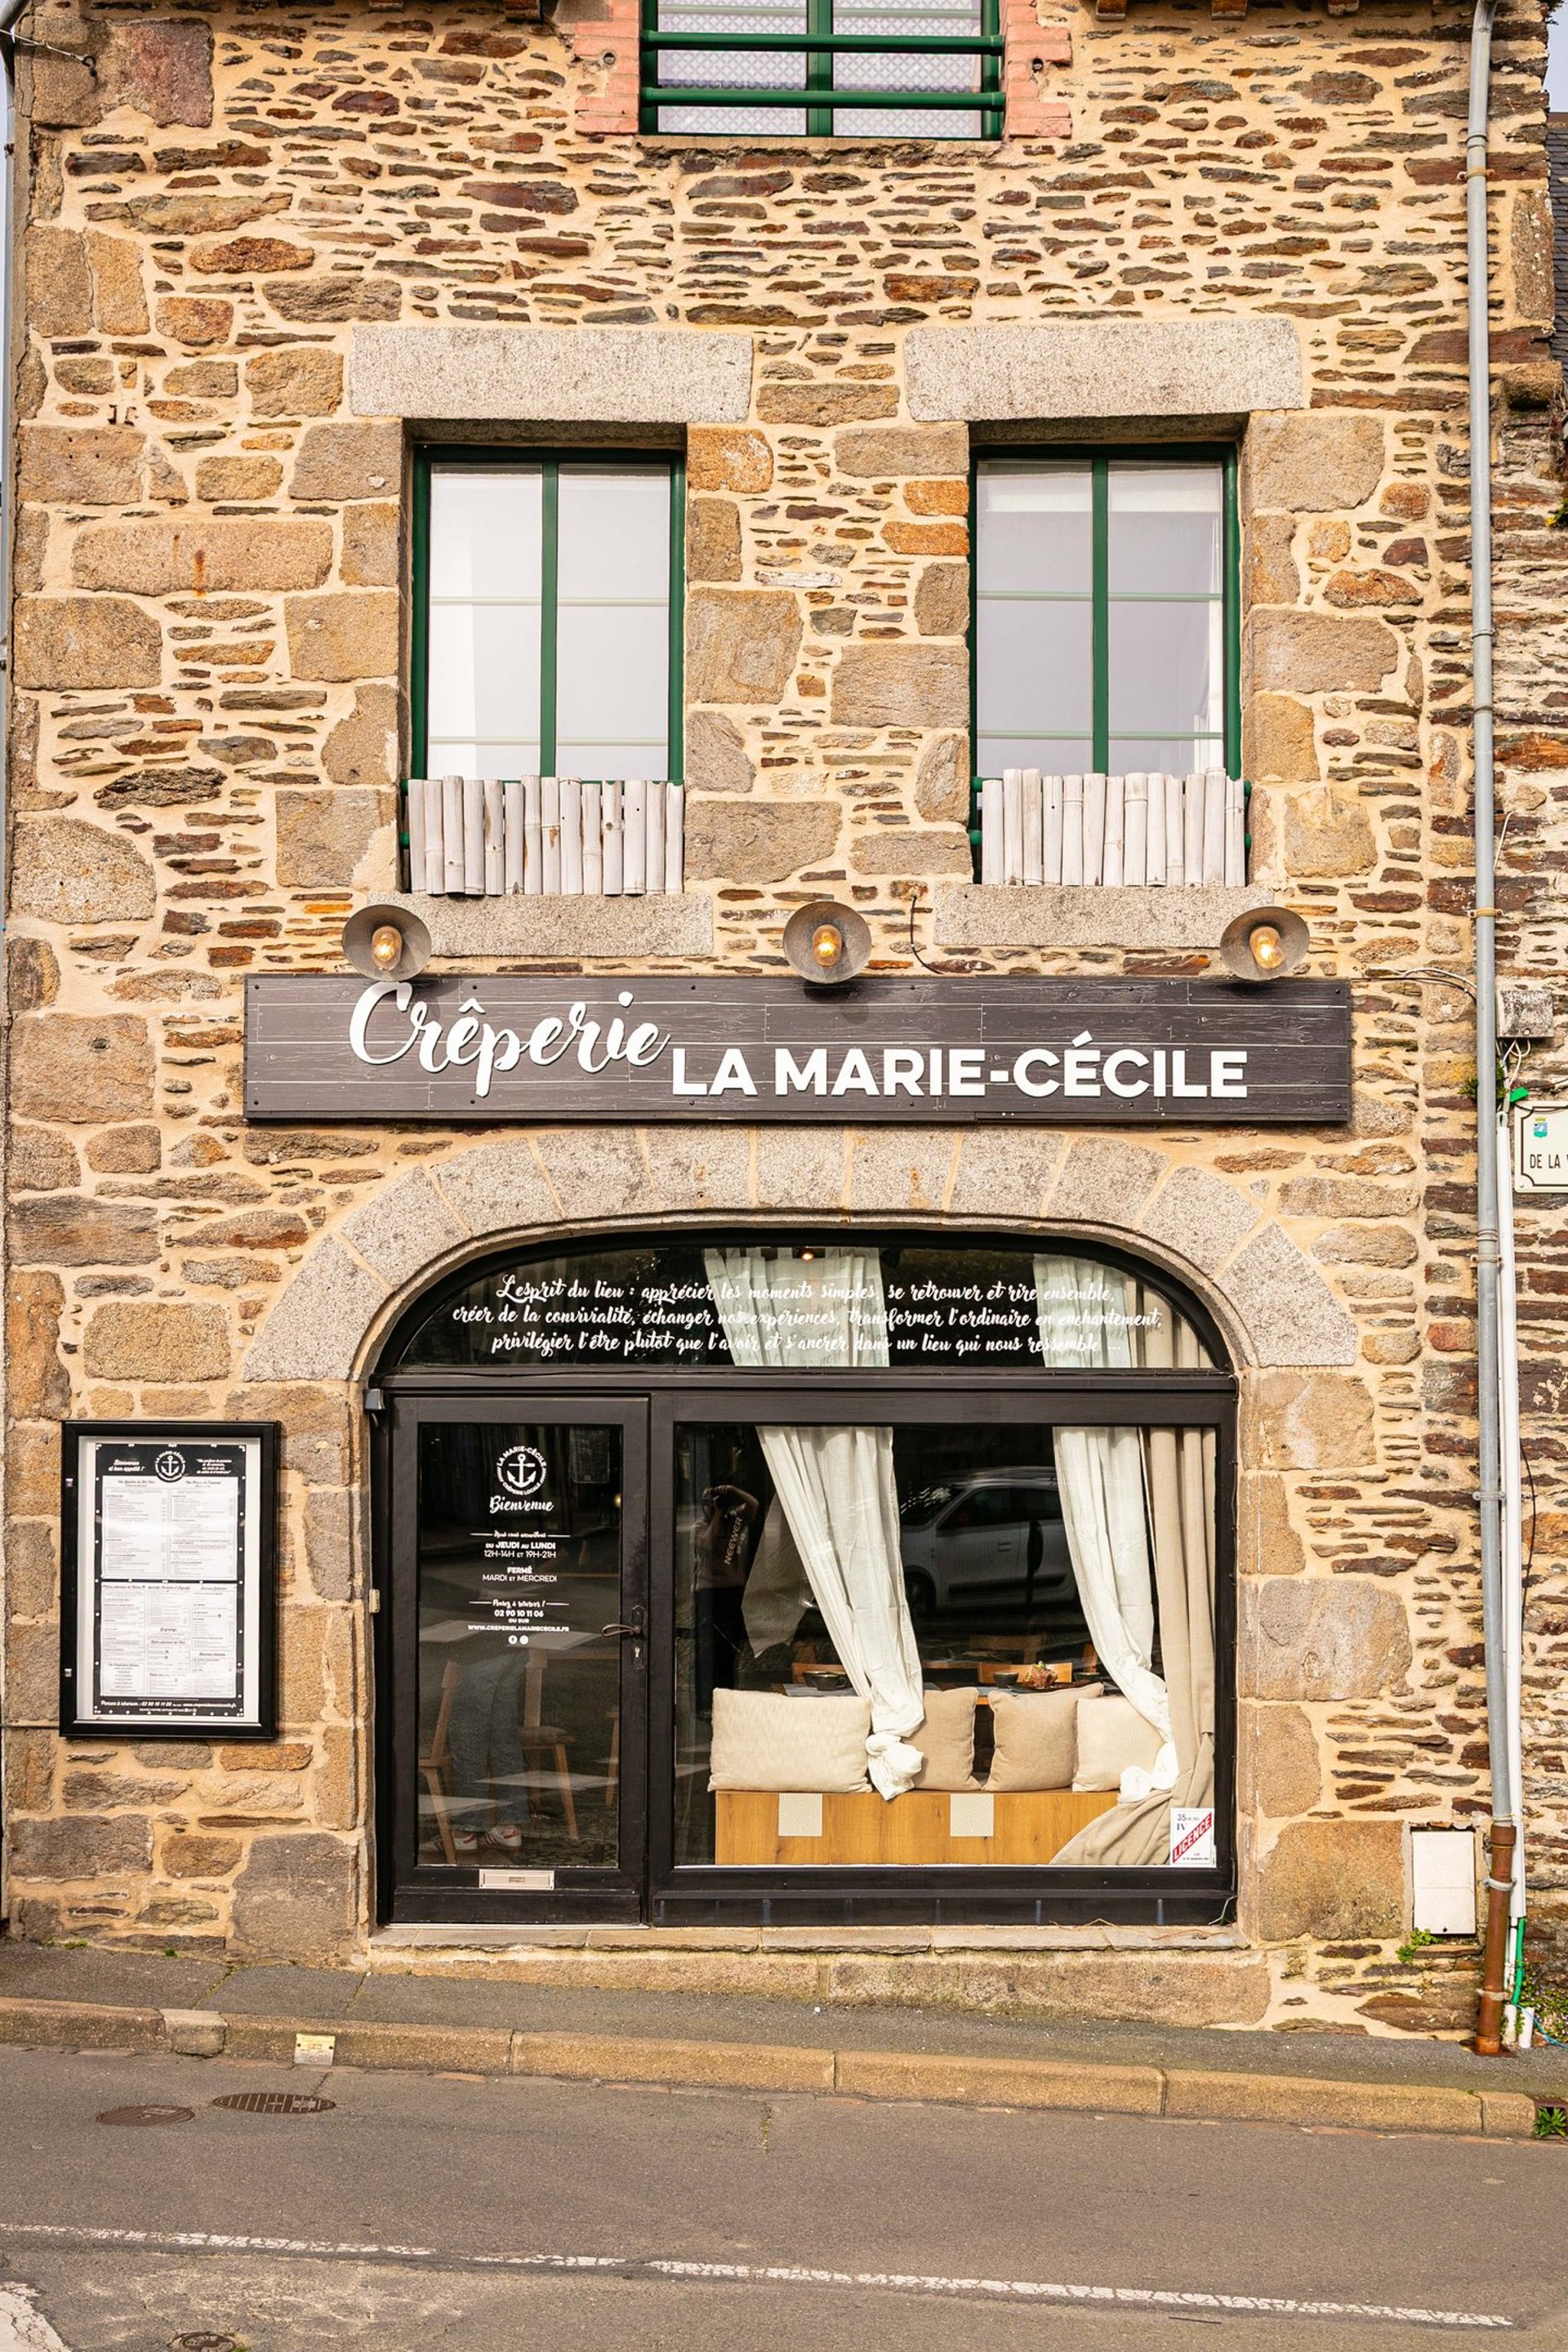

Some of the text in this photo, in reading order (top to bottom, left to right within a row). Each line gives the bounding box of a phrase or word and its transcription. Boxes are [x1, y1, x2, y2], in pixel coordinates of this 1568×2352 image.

[350, 980, 1249, 1098] Crêperie LA MARIE-CÉCILE
[1530, 1153, 1543, 1169] DE
[1548, 1153, 1561, 1169] LA
[568, 1279, 590, 1298] du
[595, 1280, 625, 1298] lieu
[641, 1282, 716, 1305] apprécier
[721, 1281, 744, 1299] les
[748, 1280, 815, 1299] moments
[821, 1282, 880, 1303] simples,
[888, 1284, 906, 1299] se
[911, 1280, 984, 1301] retrouver
[986, 1281, 1007, 1300] et
[1008, 1283, 1038, 1302] rire
[1044, 1282, 1115, 1302] ensemble,
[452, 1303, 1163, 1332] créer de la convivialité, échanger nos expériences, transformer l'ordinaire en enchantement,
[491, 1330, 574, 1357] privilégier
[578, 1330, 621, 1351] l'être
[623, 1330, 676, 1356] plutôt
[676, 1338, 704, 1356] que
[708, 1331, 760, 1352] l'avoir
[764, 1331, 784, 1350] et
[786, 1334, 849, 1352] s'ancrer
[854, 1333, 892, 1351] dans
[898, 1339, 918, 1350] un
[922, 1333, 951, 1352] lieu
[956, 1334, 982, 1357] qui
[986, 1337, 1023, 1352] nous
[1027, 1333, 1101, 1353] ressemble
[497, 1446, 547, 1468] LA MARIE-CÉCILE
[489, 1495, 555, 1514] Bienvenue
[495, 1541, 520, 1549] JEUDI
[724, 1517, 742, 1566] NEEWER
[483, 1550, 515, 1558] 12H-14H
[507, 1565, 532, 1574] FERMÉ
[1174, 1815, 1212, 1861] LICENCE
